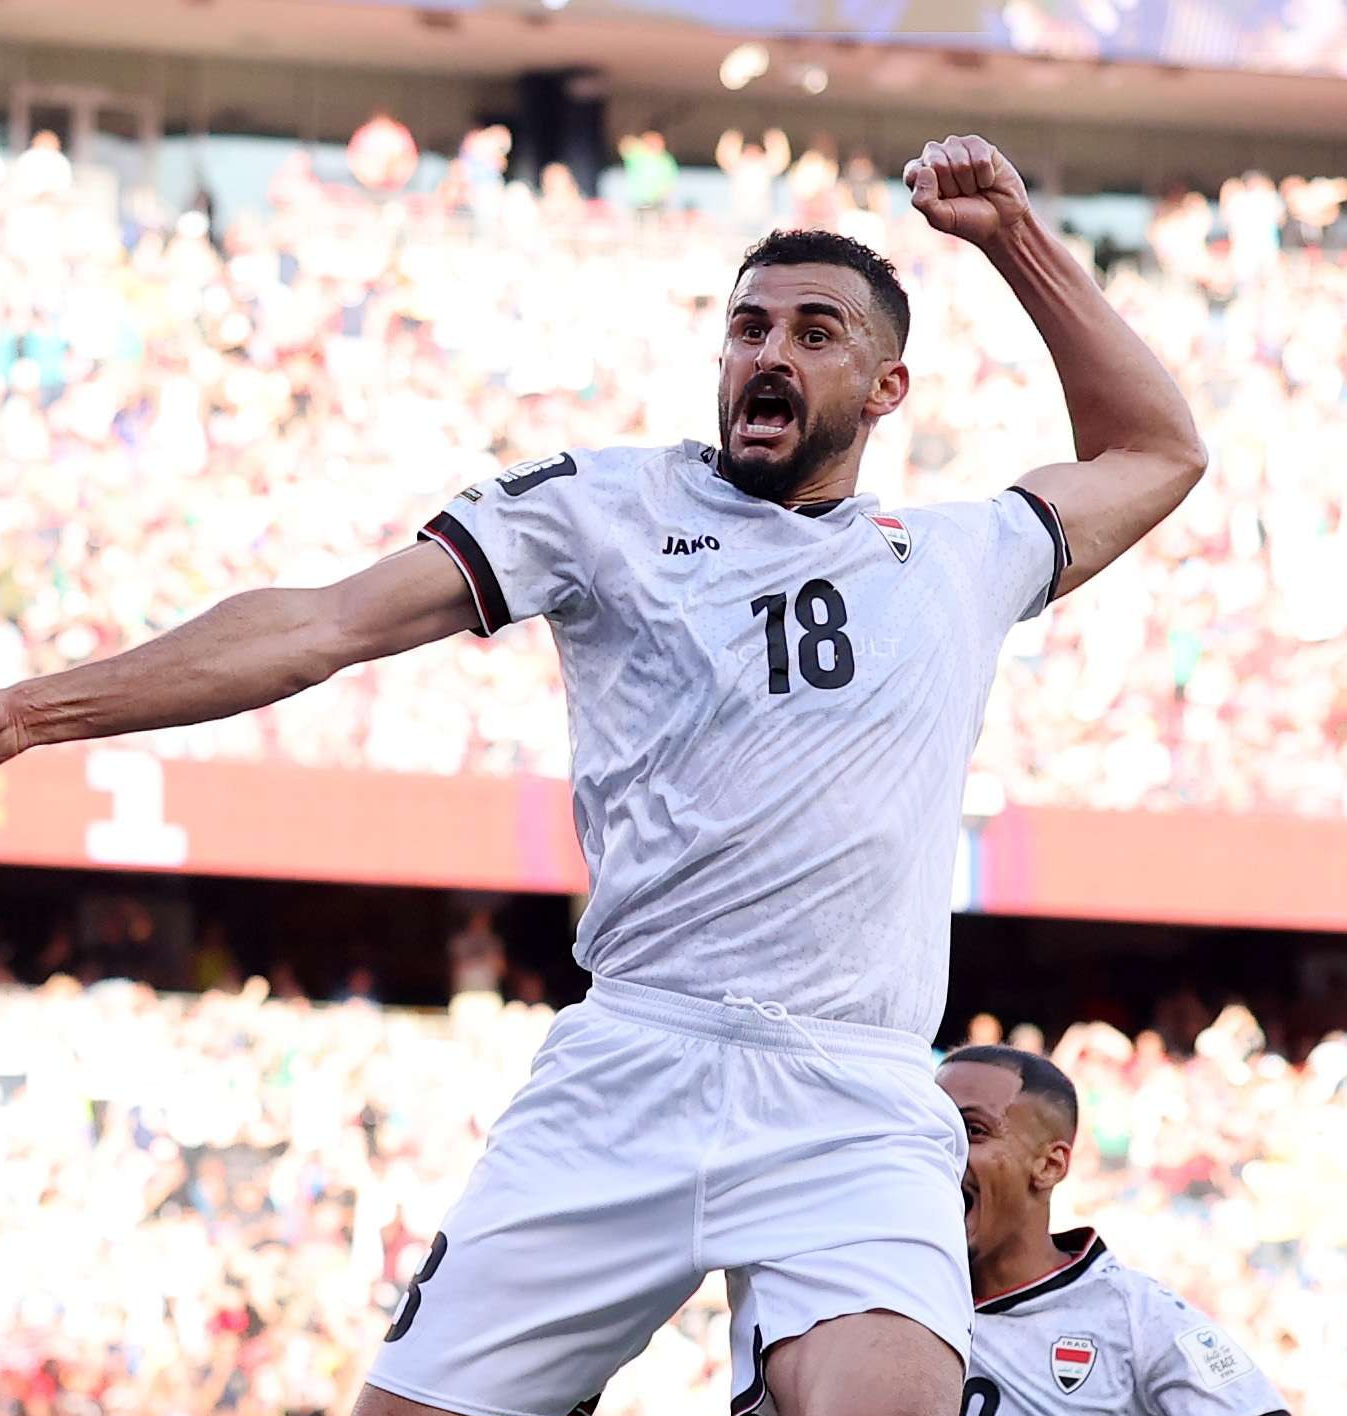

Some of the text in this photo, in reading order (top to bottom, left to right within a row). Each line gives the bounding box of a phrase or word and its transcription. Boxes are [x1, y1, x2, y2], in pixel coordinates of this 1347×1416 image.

[661, 534, 721, 556] JAKO
[750, 578, 855, 695] 18
[85, 749, 189, 866] 1
